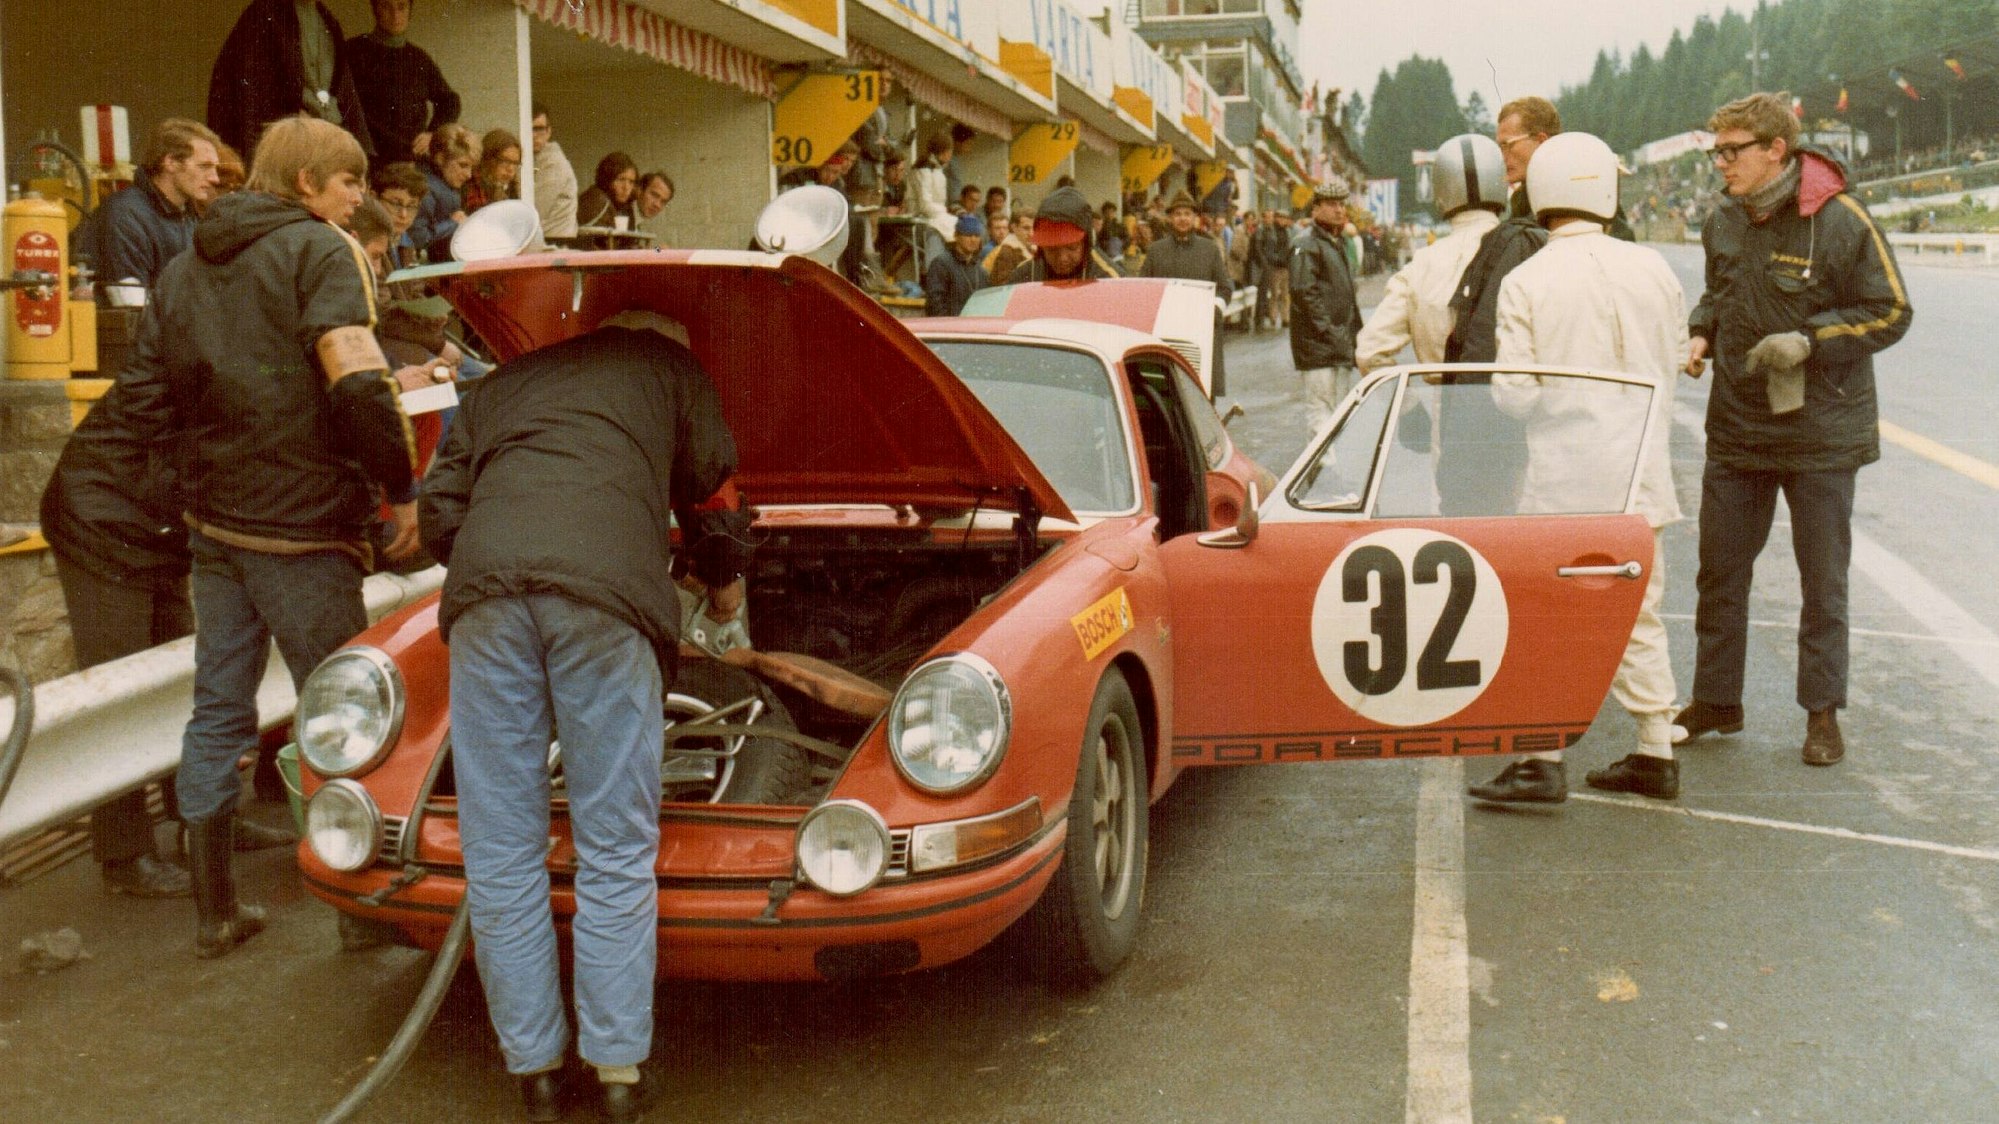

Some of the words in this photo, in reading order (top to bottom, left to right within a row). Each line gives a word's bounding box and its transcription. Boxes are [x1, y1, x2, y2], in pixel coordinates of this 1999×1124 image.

[845, 75, 873, 102] 31
[1051, 123, 1076, 141] 29
[774, 135, 813, 164] 30
[1011, 164, 1036, 182] 28
[1077, 603, 1119, 650] BOSCH
[1342, 540, 1481, 696] 32
